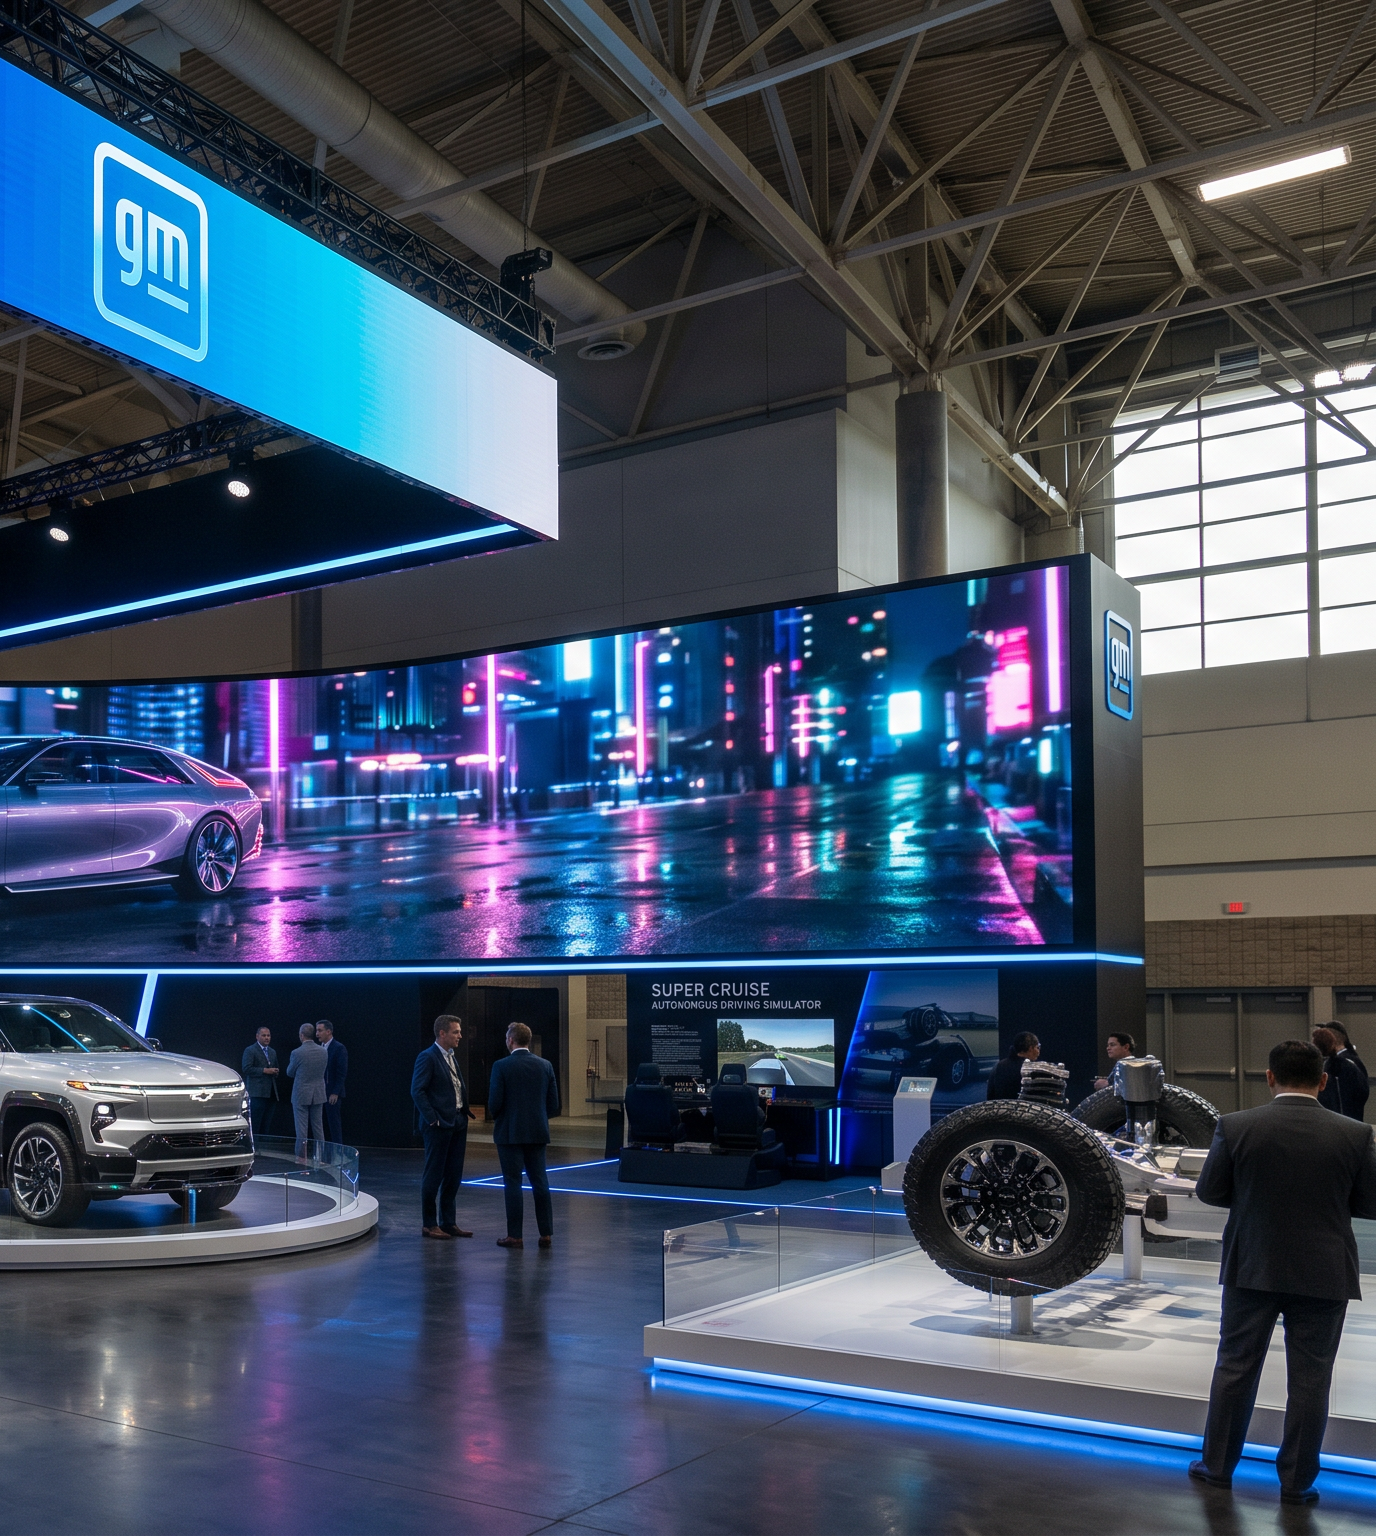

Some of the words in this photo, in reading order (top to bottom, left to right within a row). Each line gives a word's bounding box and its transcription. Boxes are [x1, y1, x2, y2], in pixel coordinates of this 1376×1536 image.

[115, 198, 189, 292] gm
[1110, 637, 1130, 689] gm
[651, 983, 704, 997] SUPER
[709, 982, 770, 997] CRUISE
[720, 1000, 761, 1010] DRIVING
[763, 1000, 822, 1010] SIMULATOR
